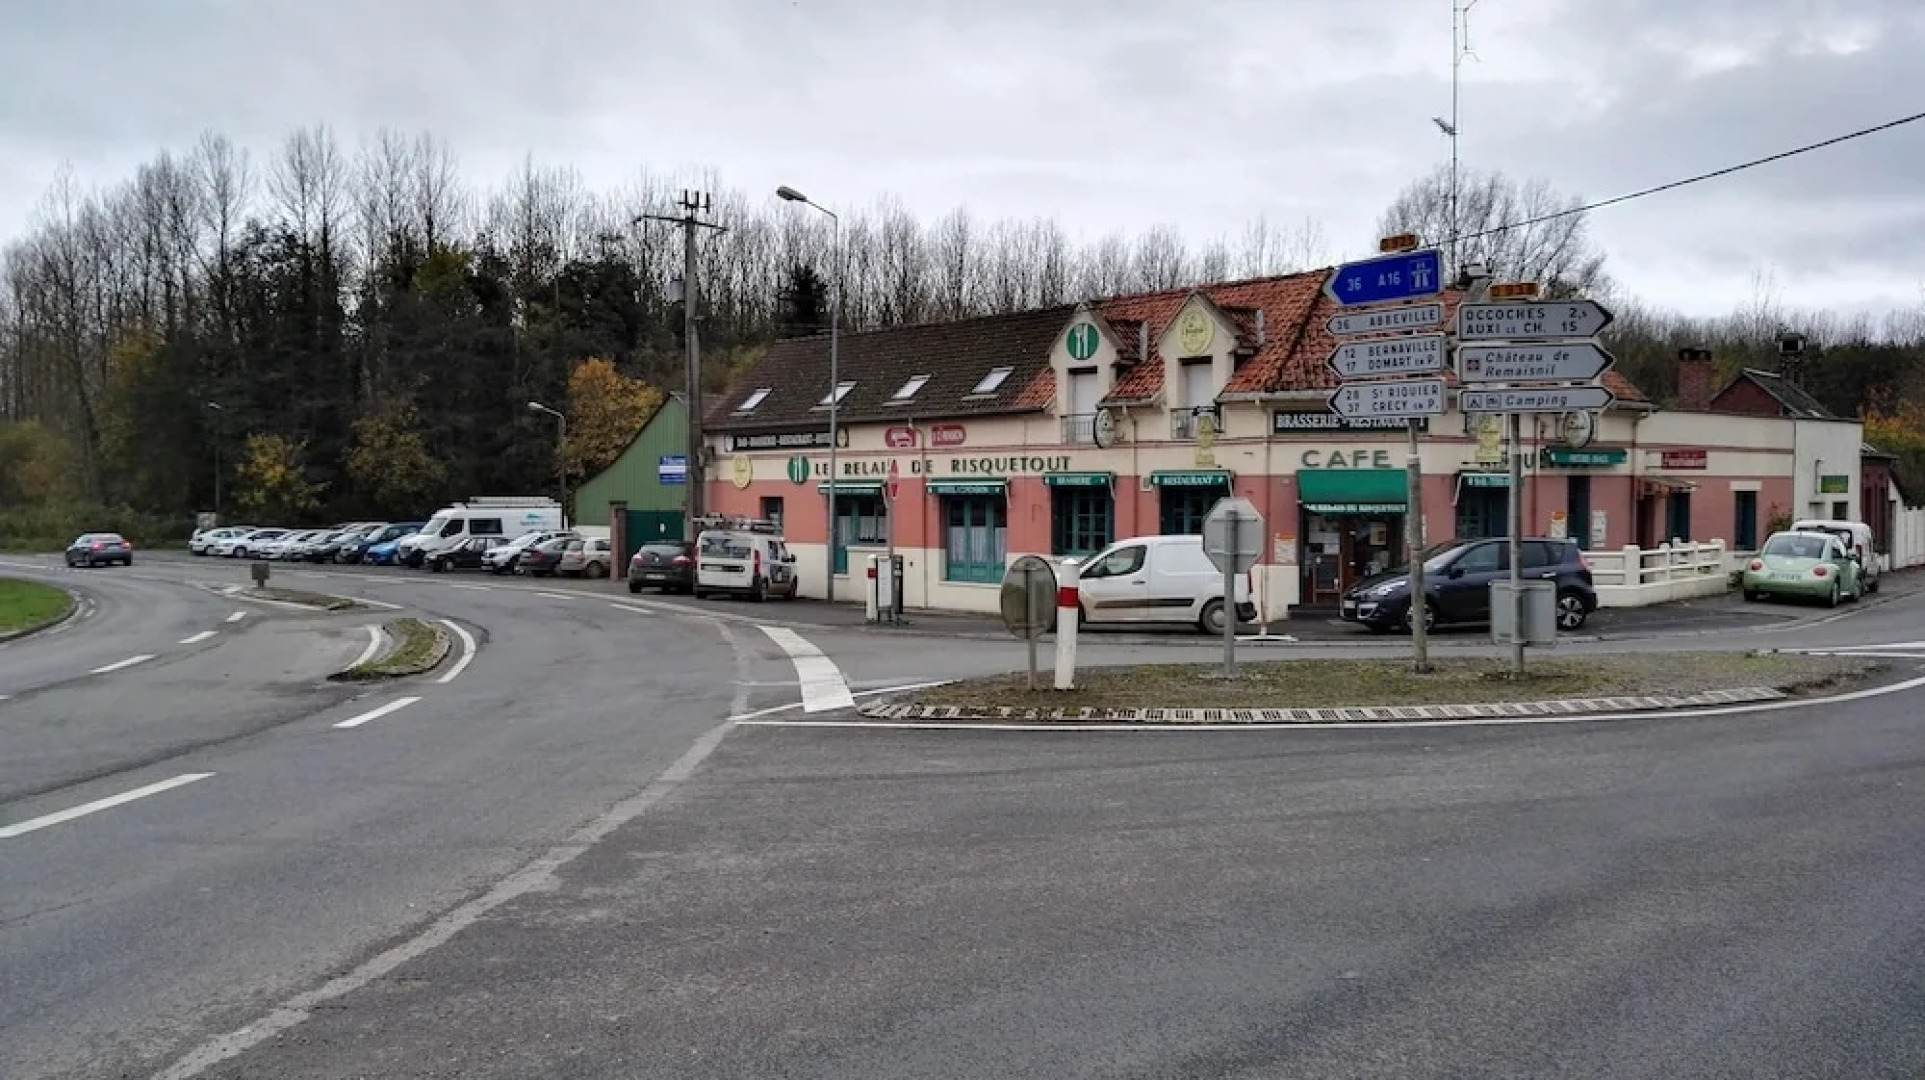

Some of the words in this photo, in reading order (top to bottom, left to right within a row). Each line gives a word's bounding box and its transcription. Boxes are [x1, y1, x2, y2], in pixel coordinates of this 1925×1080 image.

[1346, 276, 1362, 292] 36
[1377, 270, 1401, 286] A16
[1337, 319, 1350, 330] 36
[1369, 309, 1436, 326] ABBEVILLE
[1466, 307, 1546, 321] OCCOCHES
[1466, 322, 1501, 335] AUXI
[1561, 320, 1578, 332] 15
[1344, 347, 1356, 359] 12
[1368, 340, 1437, 357] BERNAVILLE
[1485, 351, 1544, 364] Château
[1552, 349, 1571, 361] de
[1345, 361, 1357, 372] 17
[1368, 356, 1412, 371] DOMART
[1485, 364, 1557, 378] Remaisnil
[1388, 384, 1439, 398] RIQUIER
[1505, 394, 1569, 408] Camping
[1276, 413, 1341, 429] BRASSERIE
[815, 462, 829, 476] LE
[844, 460, 889, 477] RELAI
[911, 459, 934, 475] DE
[950, 455, 1072, 476] RISQUETOUT
[1301, 449, 1393, 469] CAFE
[1163, 476, 1214, 486] RESTAURANT
